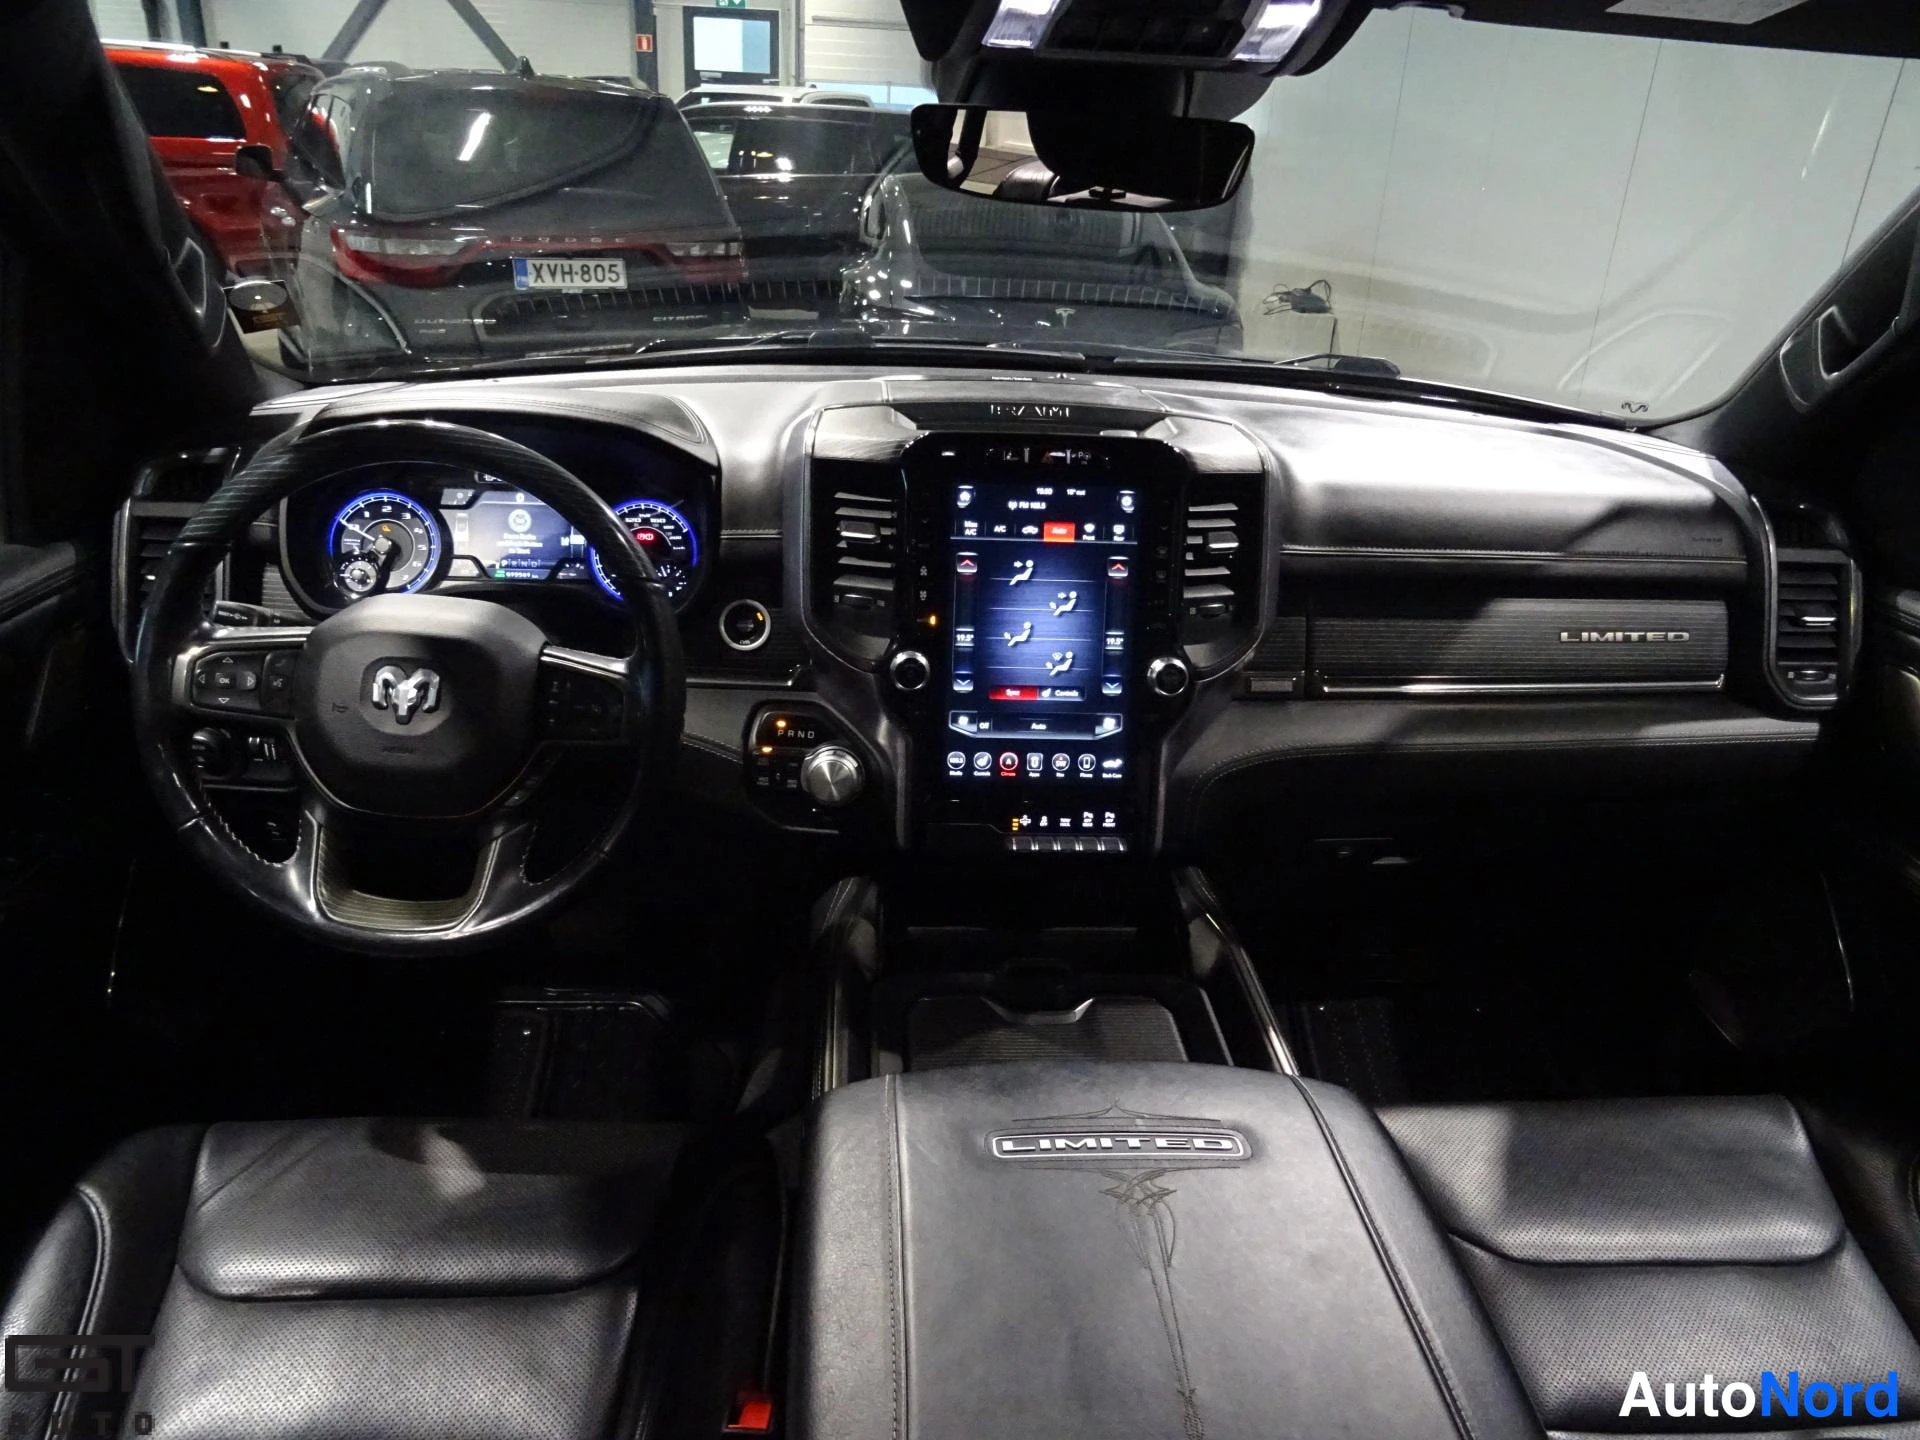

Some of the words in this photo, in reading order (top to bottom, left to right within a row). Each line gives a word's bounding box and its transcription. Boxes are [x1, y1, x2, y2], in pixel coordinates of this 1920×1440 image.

[531, 262, 621, 284] XVH-805
[1559, 631, 1690, 643] LIMITED
[218, 677, 230, 685] OK
[1001, 1136, 1233, 1152] LIMITED
